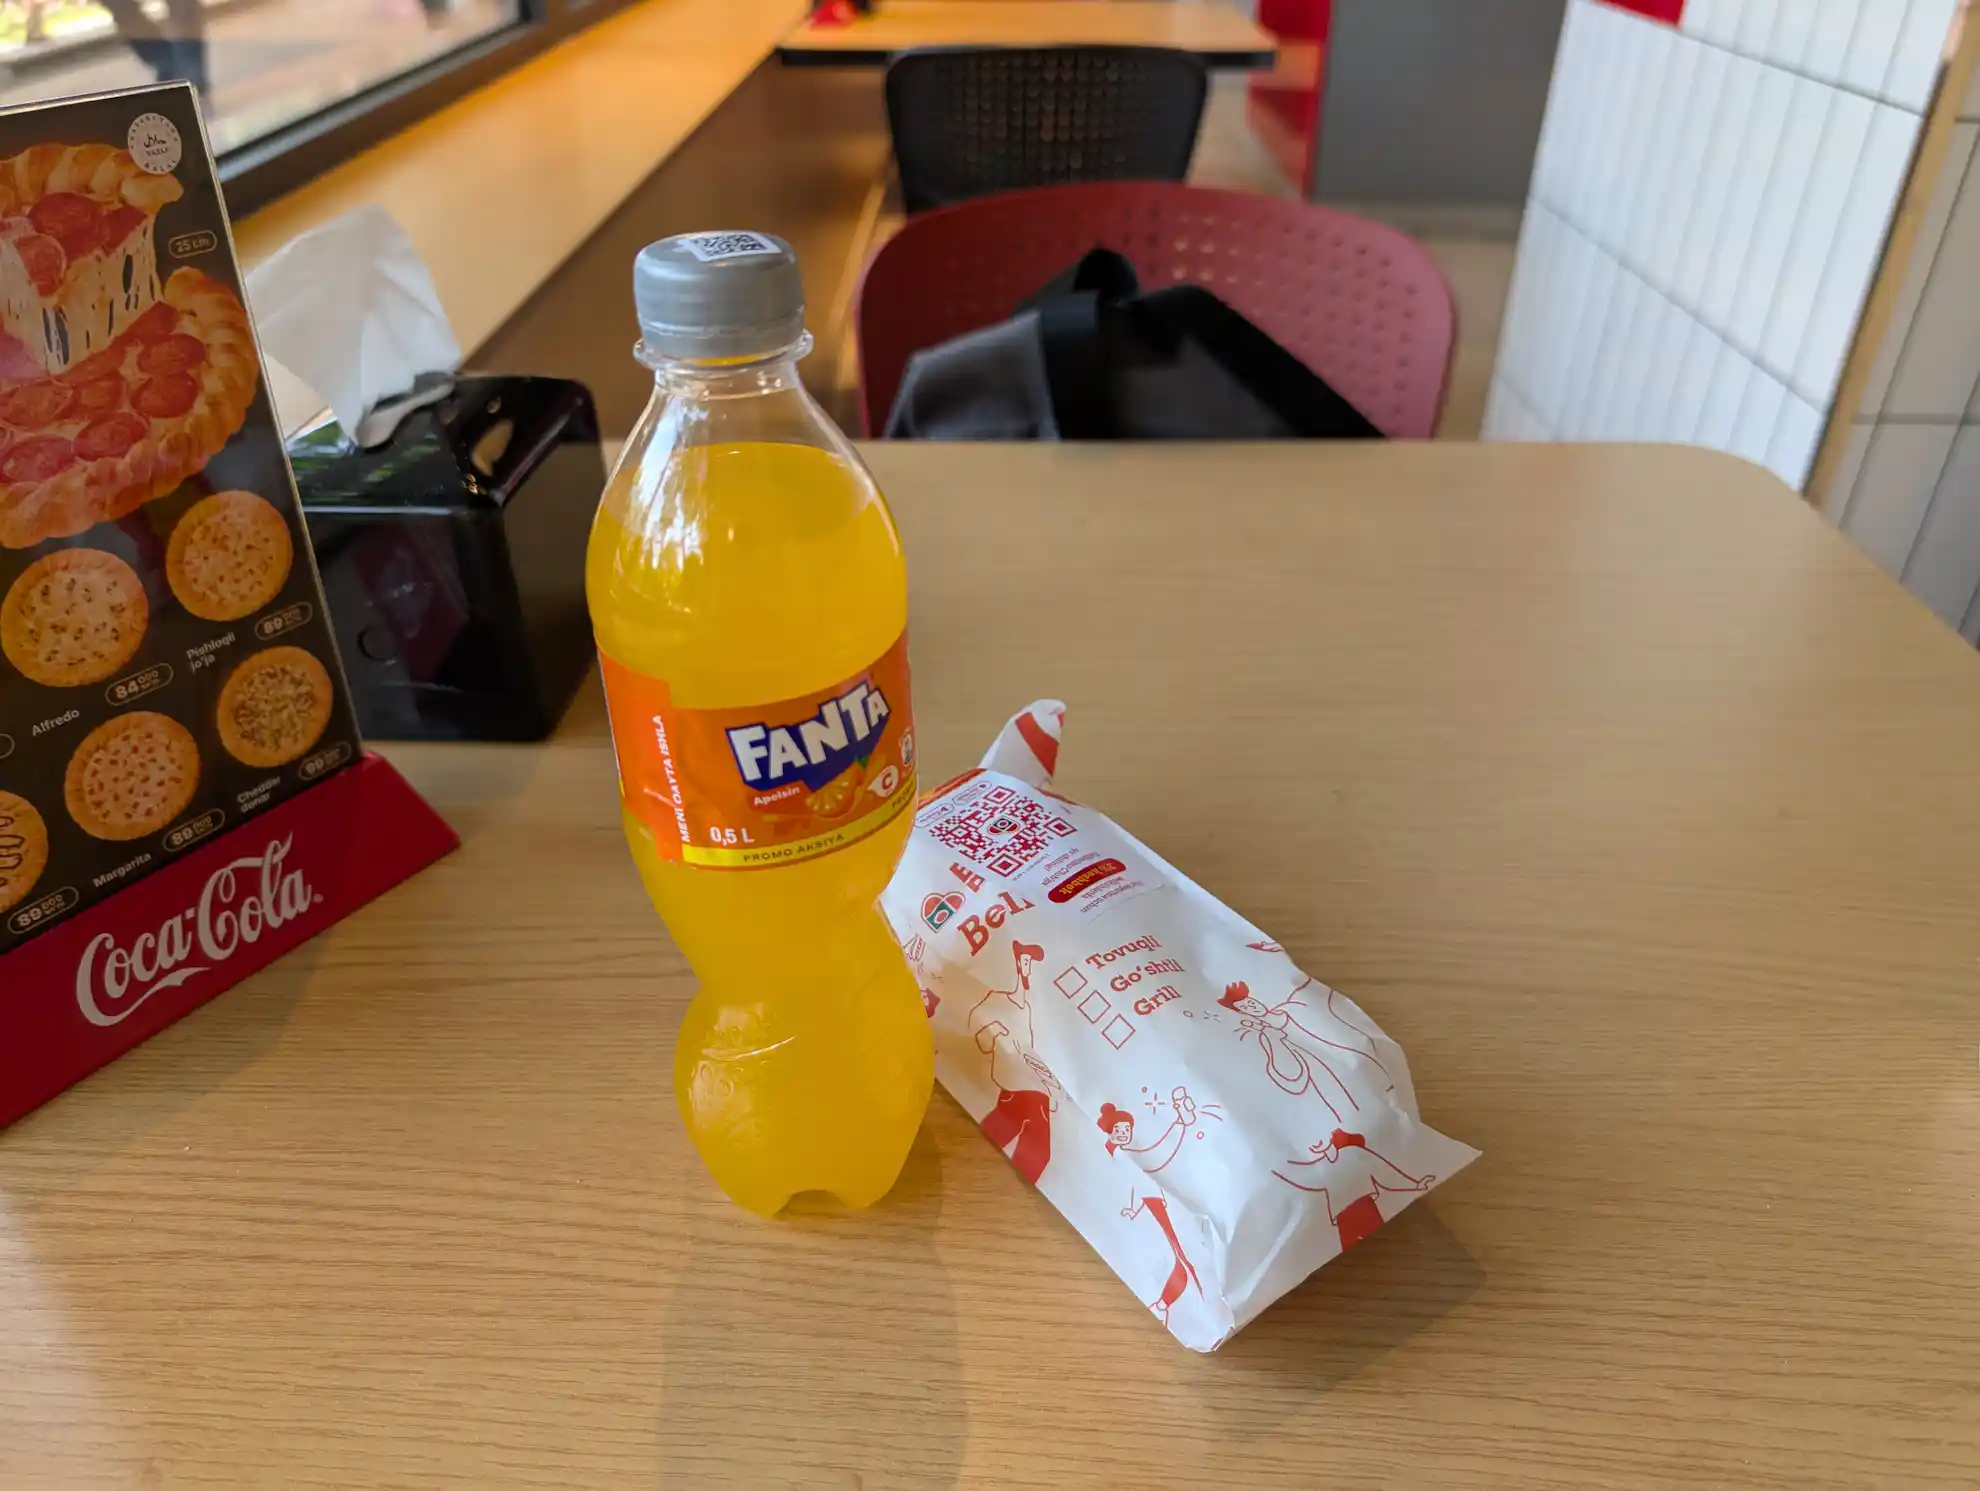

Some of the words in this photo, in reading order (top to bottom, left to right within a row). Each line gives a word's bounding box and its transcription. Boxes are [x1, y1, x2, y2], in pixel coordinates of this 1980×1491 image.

[175, 240, 191, 252] 25
[186, 631, 236, 660] Pishloqli
[115, 681, 139, 699] 84
[31, 708, 80, 737] Alfredo
[726, 681, 891, 783] FANTA
[753, 786, 801, 806] Apelsin
[171, 827, 194, 846] 89
[674, 807, 690, 843] MENI
[709, 826, 738, 847] 0,5
[743, 828, 755, 845] L
[743, 848, 793, 863] PROMO
[796, 833, 845, 857] AKSIYA
[93, 851, 153, 889] Margarita
[17, 908, 43, 928] 89
[41, 893, 64, 911] 000
[76, 831, 312, 1027] Coca-Cola
[1085, 934, 1164, 970] Tovuqli
[1132, 984, 1184, 1017] Grill
